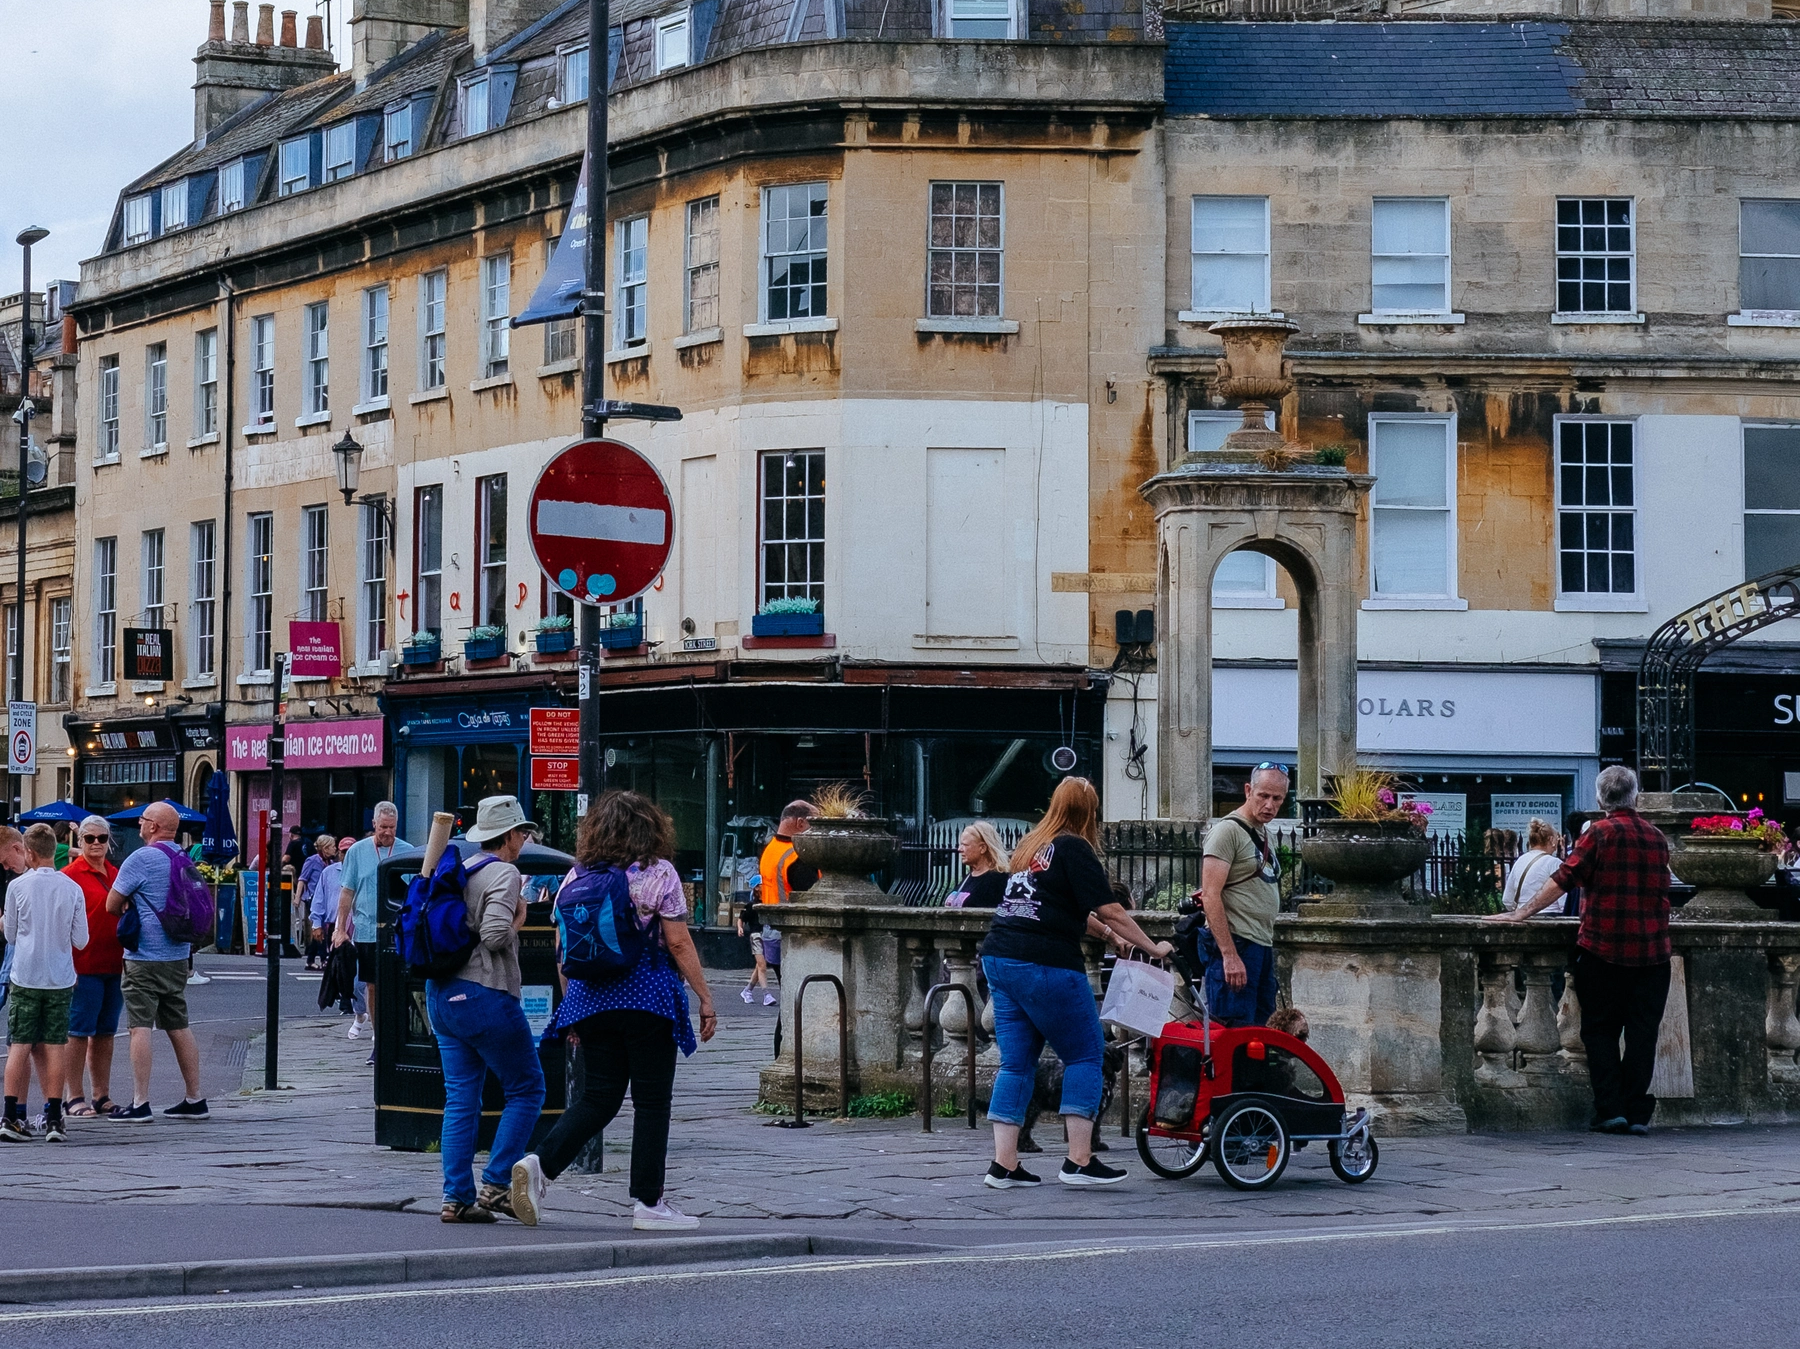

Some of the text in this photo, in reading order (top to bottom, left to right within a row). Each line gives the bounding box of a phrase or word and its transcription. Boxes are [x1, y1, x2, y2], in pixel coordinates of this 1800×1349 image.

[1677, 582, 1763, 645] THE
[145, 633, 160, 645] REAL
[309, 636, 321, 644] The
[685, 639, 715, 649] YORK STREET
[136, 644, 161, 657] ITALIAN
[1357, 698, 1456, 718] OLARS
[1773, 694, 1800, 725] S
[13, 718, 31, 728] ZONE
[457, 711, 511, 728] Casa de Tapas
[232, 736, 248, 759] The
[251, 738, 268, 760] Rea
[284, 733, 305, 757] lian
[325, 733, 359, 755] Cream
[547, 761, 568, 769] STOP
[1494, 800, 1559, 808] BACK TO SCHOOL
